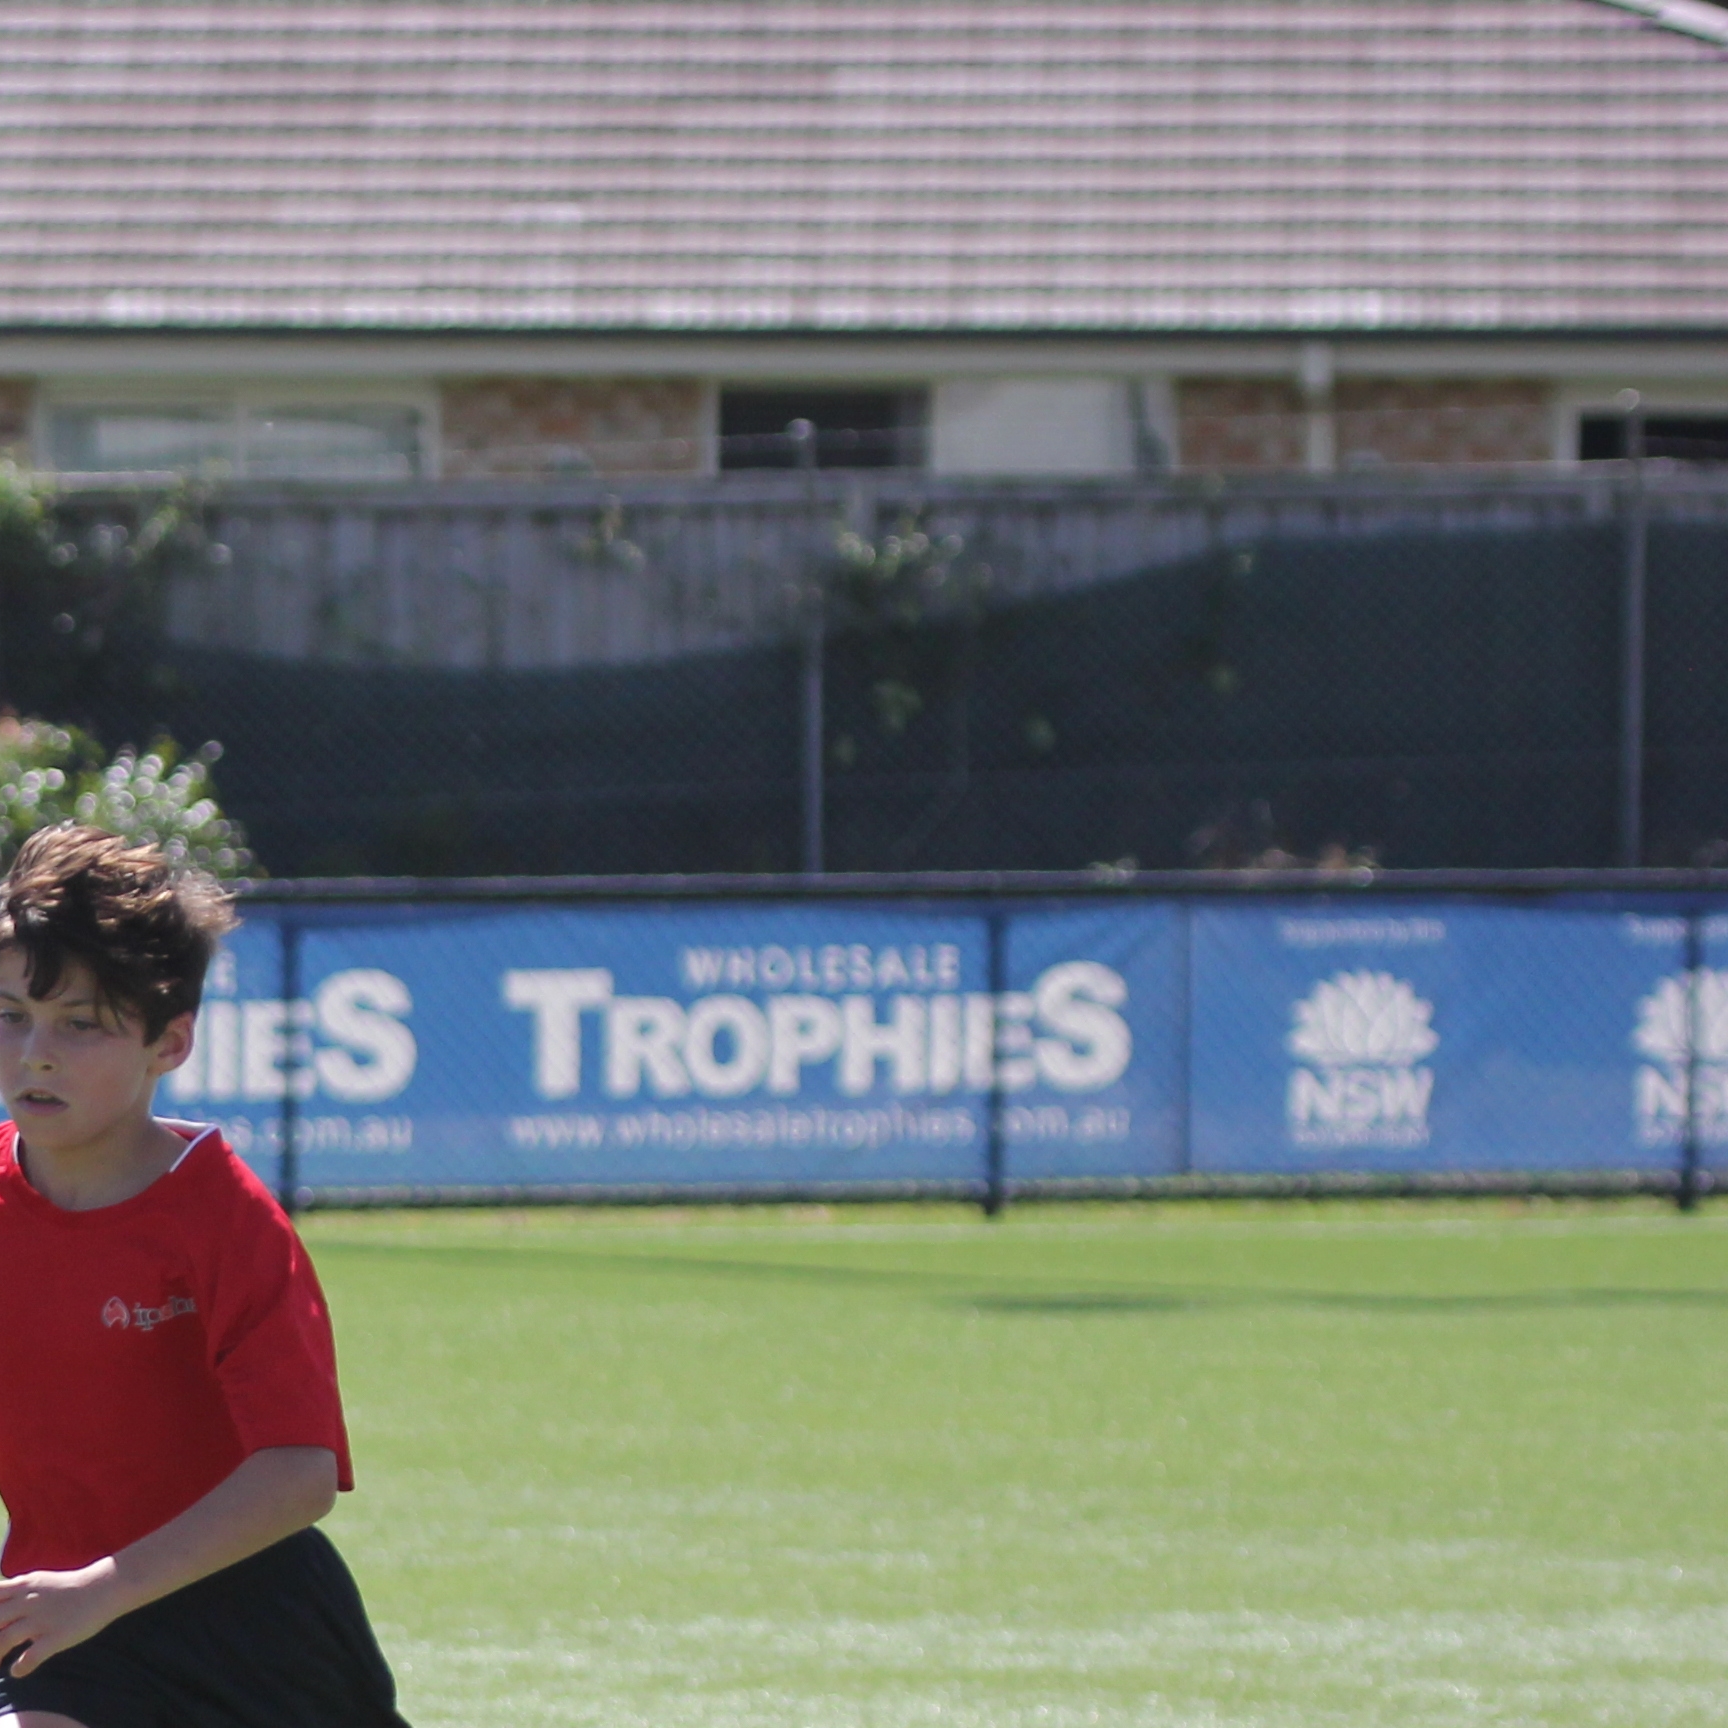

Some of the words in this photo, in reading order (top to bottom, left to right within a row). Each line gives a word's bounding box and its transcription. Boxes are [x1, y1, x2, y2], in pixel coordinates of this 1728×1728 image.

[682, 944, 961, 990] WHOLESALE
[502, 960, 1134, 1098] TROPHIES
[1288, 1067, 1435, 1122] NSW
[507, 1105, 1132, 1151] www.wholesaletrophies.om.au
